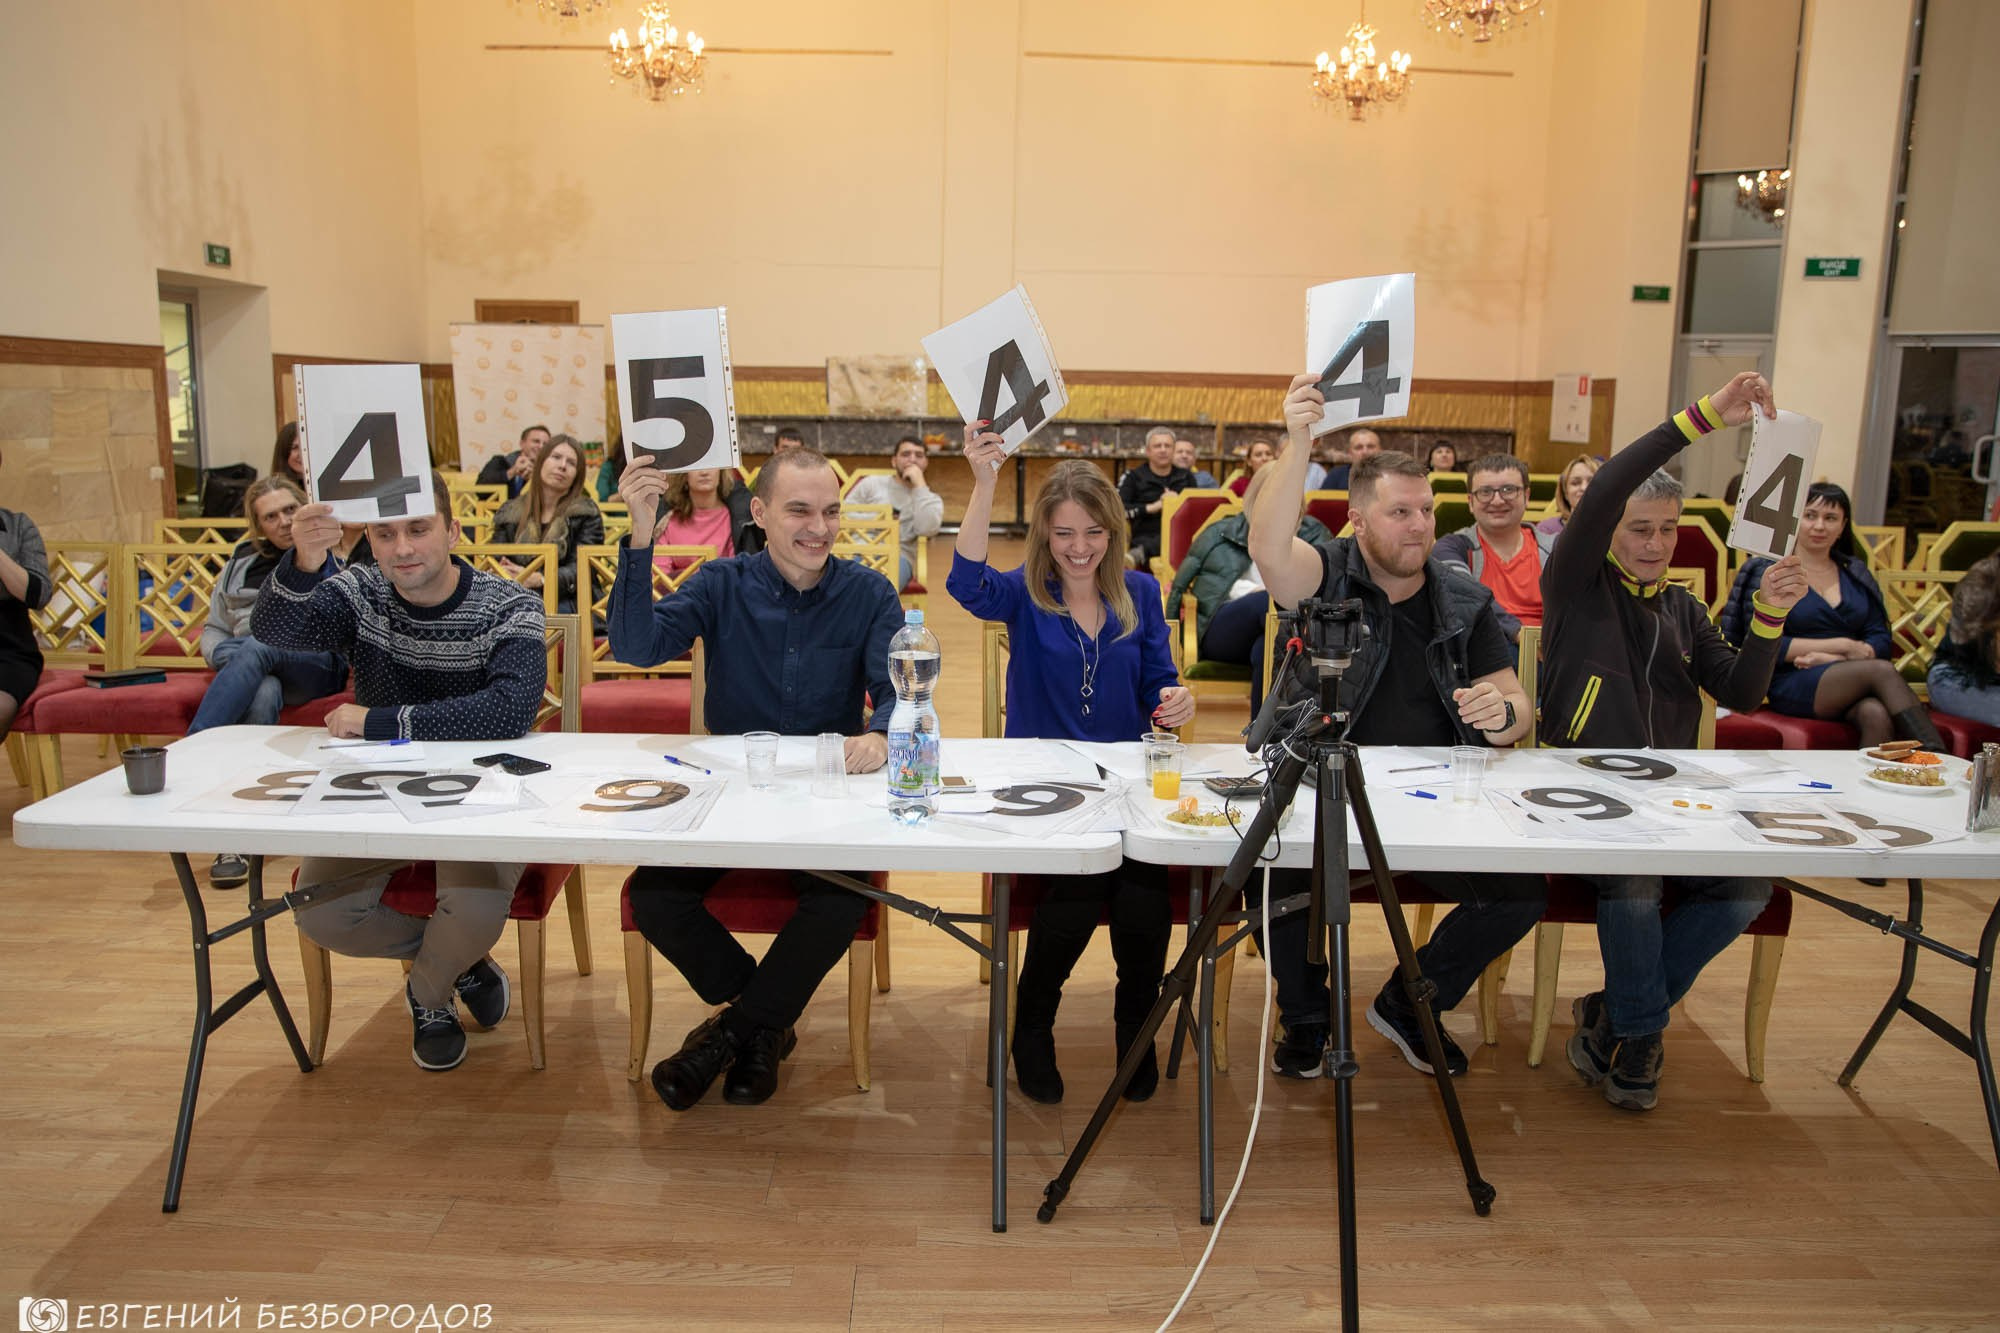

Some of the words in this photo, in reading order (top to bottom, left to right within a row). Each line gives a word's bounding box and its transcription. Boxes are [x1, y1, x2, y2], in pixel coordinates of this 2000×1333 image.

[628, 355, 715, 470] 5
[976, 339, 1051, 434] 4
[1313, 320, 1401, 418] 4
[317, 412, 421, 517] 4
[1743, 453, 1804, 557] 4
[1737, 811, 1858, 847] 5
